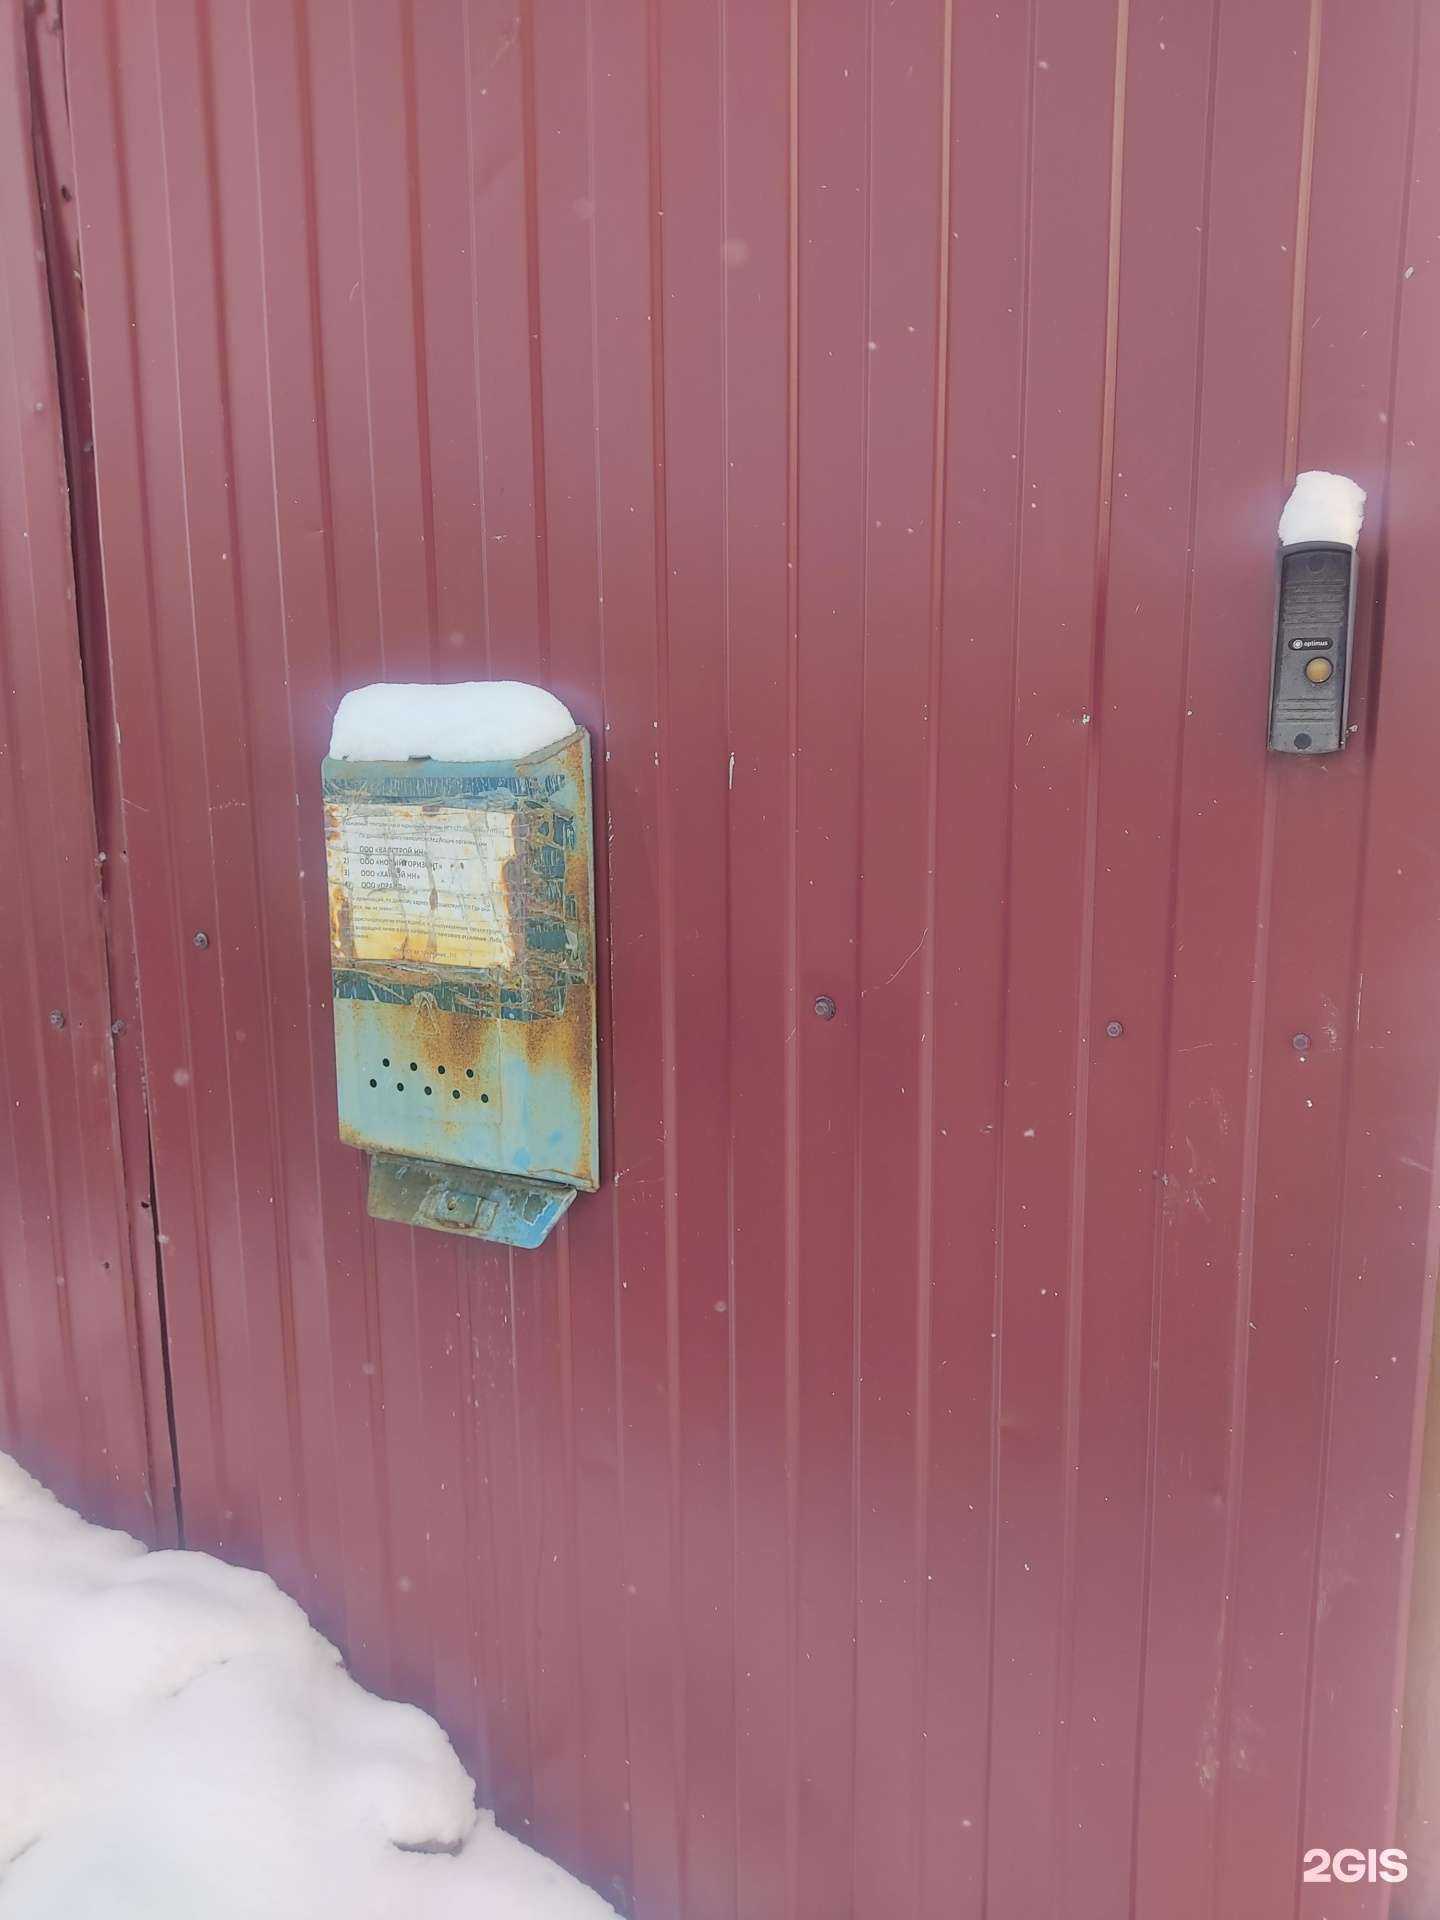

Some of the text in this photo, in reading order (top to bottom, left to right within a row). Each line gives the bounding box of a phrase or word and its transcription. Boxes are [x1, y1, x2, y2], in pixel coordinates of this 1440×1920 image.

[1303, 640, 1329, 648] optimus
[359, 845, 374, 854] ООО
[360, 858, 375, 866] ООО
[361, 881, 376, 889] ООО
